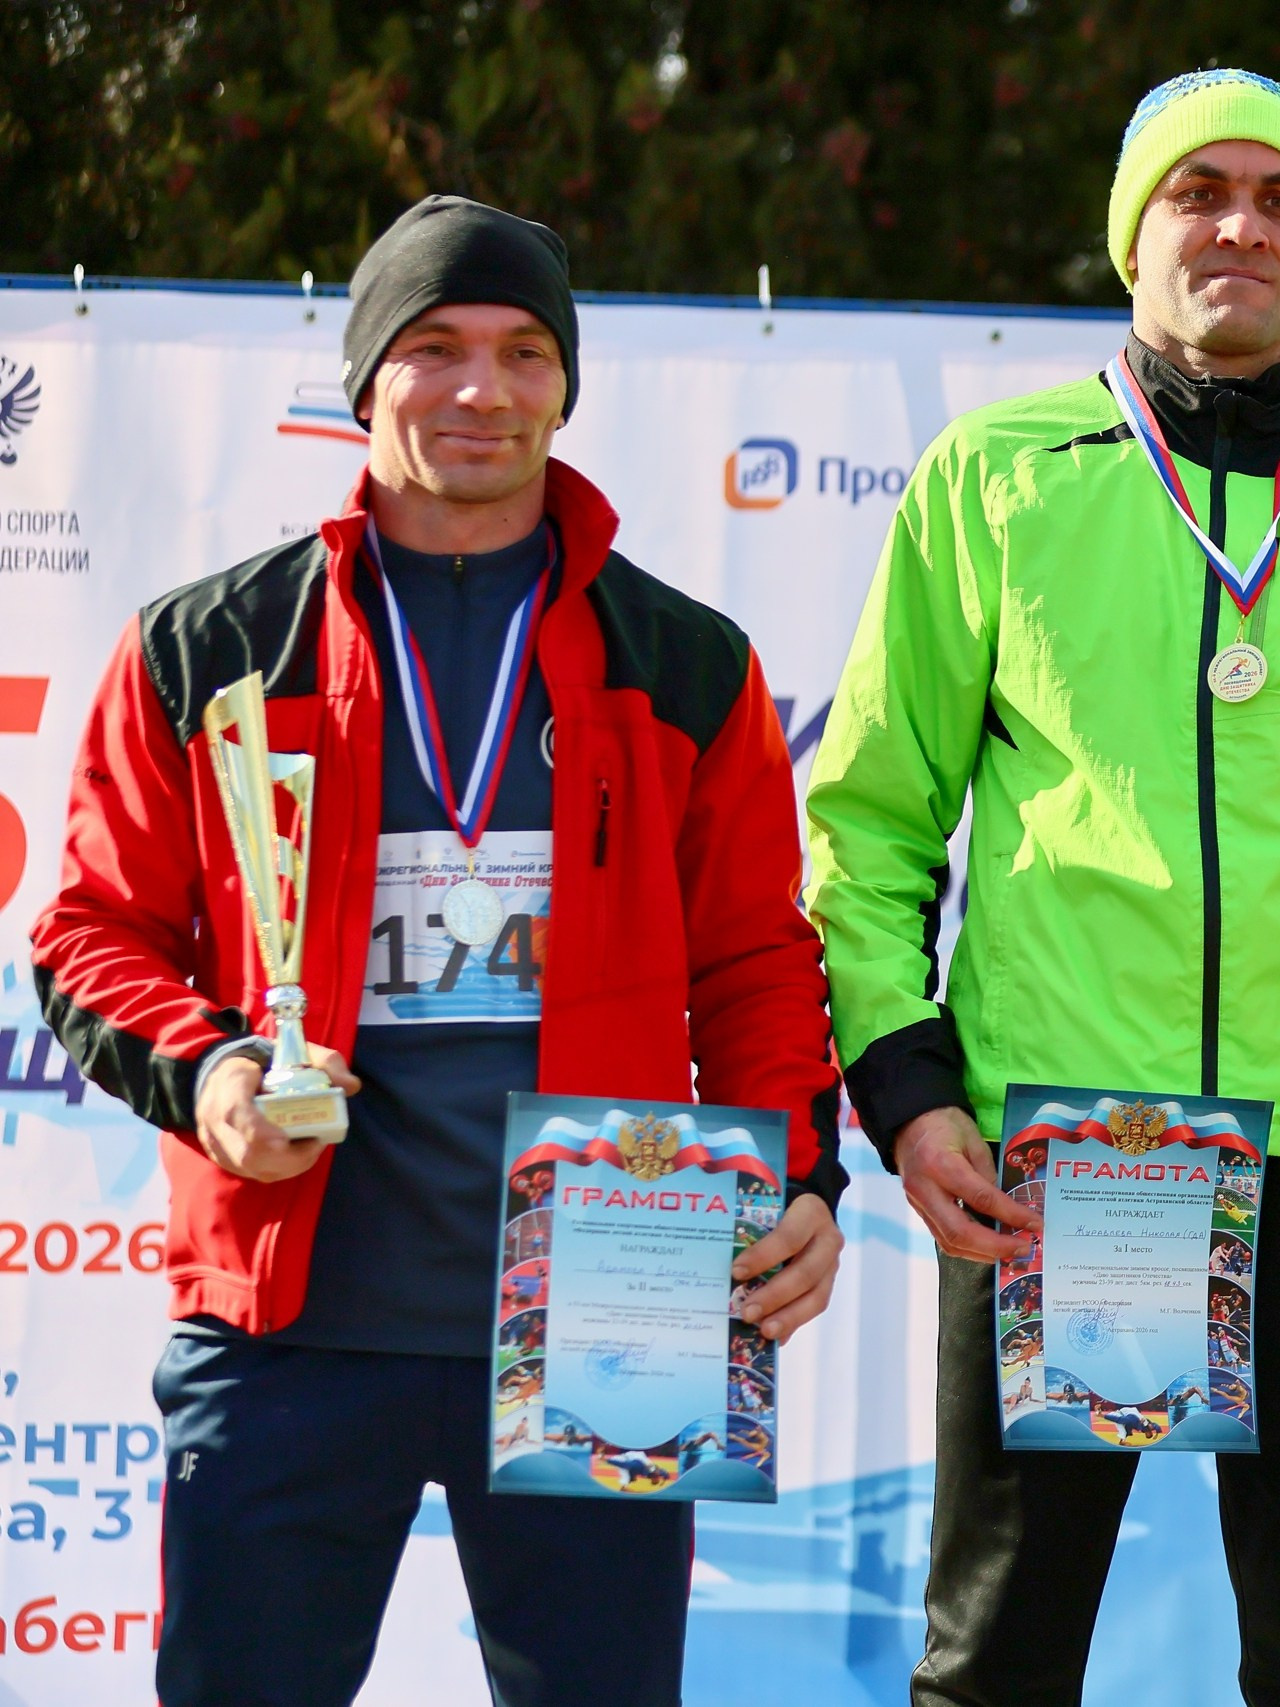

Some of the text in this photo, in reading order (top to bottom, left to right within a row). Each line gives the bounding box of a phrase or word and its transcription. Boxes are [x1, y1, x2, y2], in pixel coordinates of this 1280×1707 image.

[8, 510, 80, 535] СПОРТА
[486, 862, 536, 874] ЗИМНИЙ
[372, 914, 542, 996] 174
[1054, 1160, 1210, 1183] ГРАМОТА
[562, 1186, 729, 1214] ГРАМОТА
[1105, 1210, 1165, 1219] НАГРАЖДАЕТ
[0, 1220, 164, 1274] 2026
[1114, 1243, 1153, 1254] За I место
